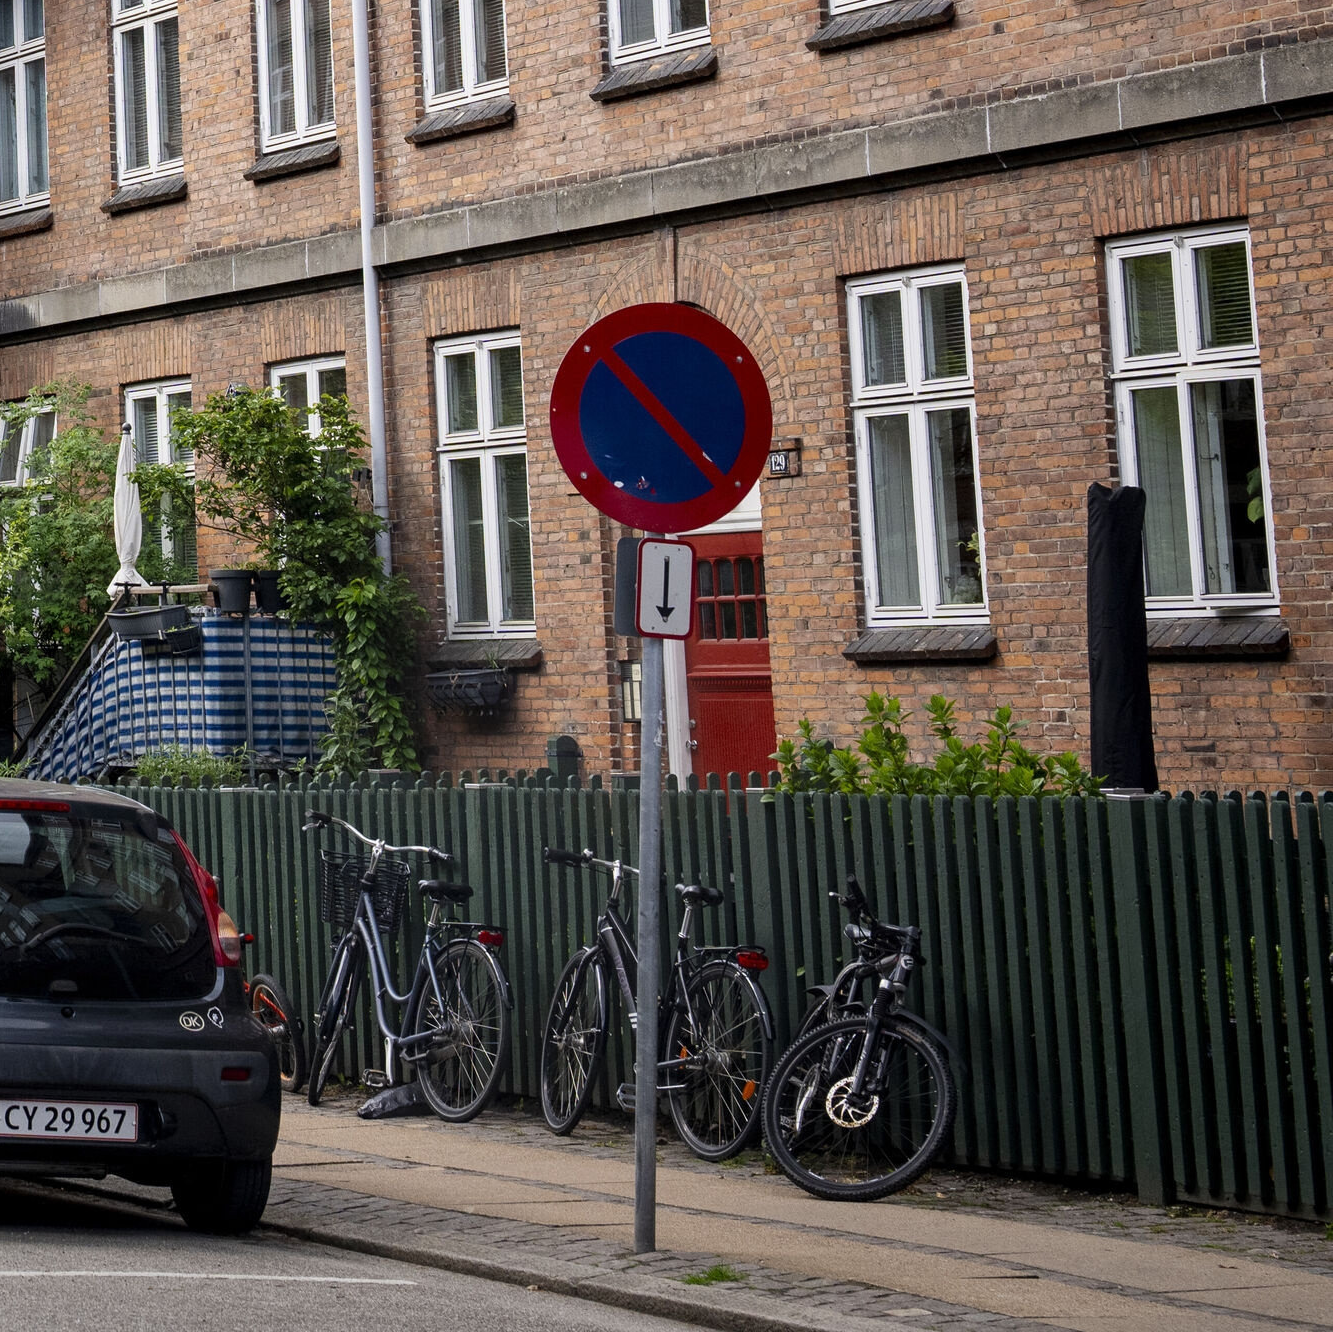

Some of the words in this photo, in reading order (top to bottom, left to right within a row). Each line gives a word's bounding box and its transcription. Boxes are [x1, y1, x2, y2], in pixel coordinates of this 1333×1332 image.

[771, 454, 786, 471] 129
[4, 1105, 38, 1130] CY
[44, 1106, 75, 1133] 29
[81, 1108, 127, 1134] 967
